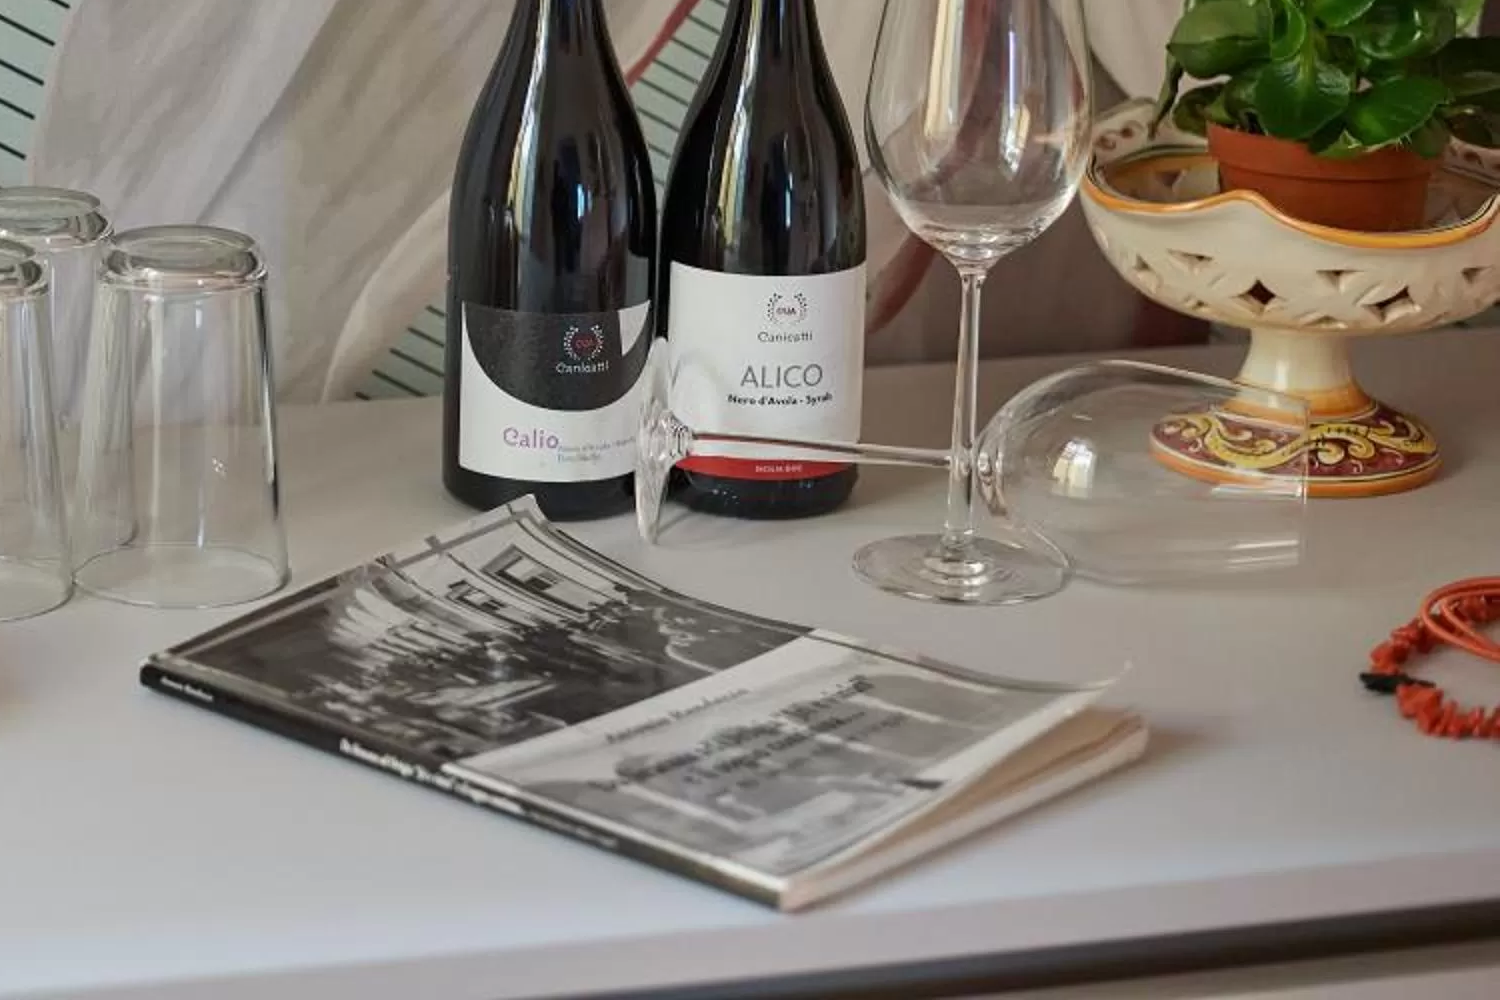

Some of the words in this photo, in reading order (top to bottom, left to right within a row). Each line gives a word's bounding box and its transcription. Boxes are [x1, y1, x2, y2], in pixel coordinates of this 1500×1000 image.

[740, 363, 823, 389] ALICO
[727, 393, 756, 405] Nero
[503, 426, 560, 449] Calio
